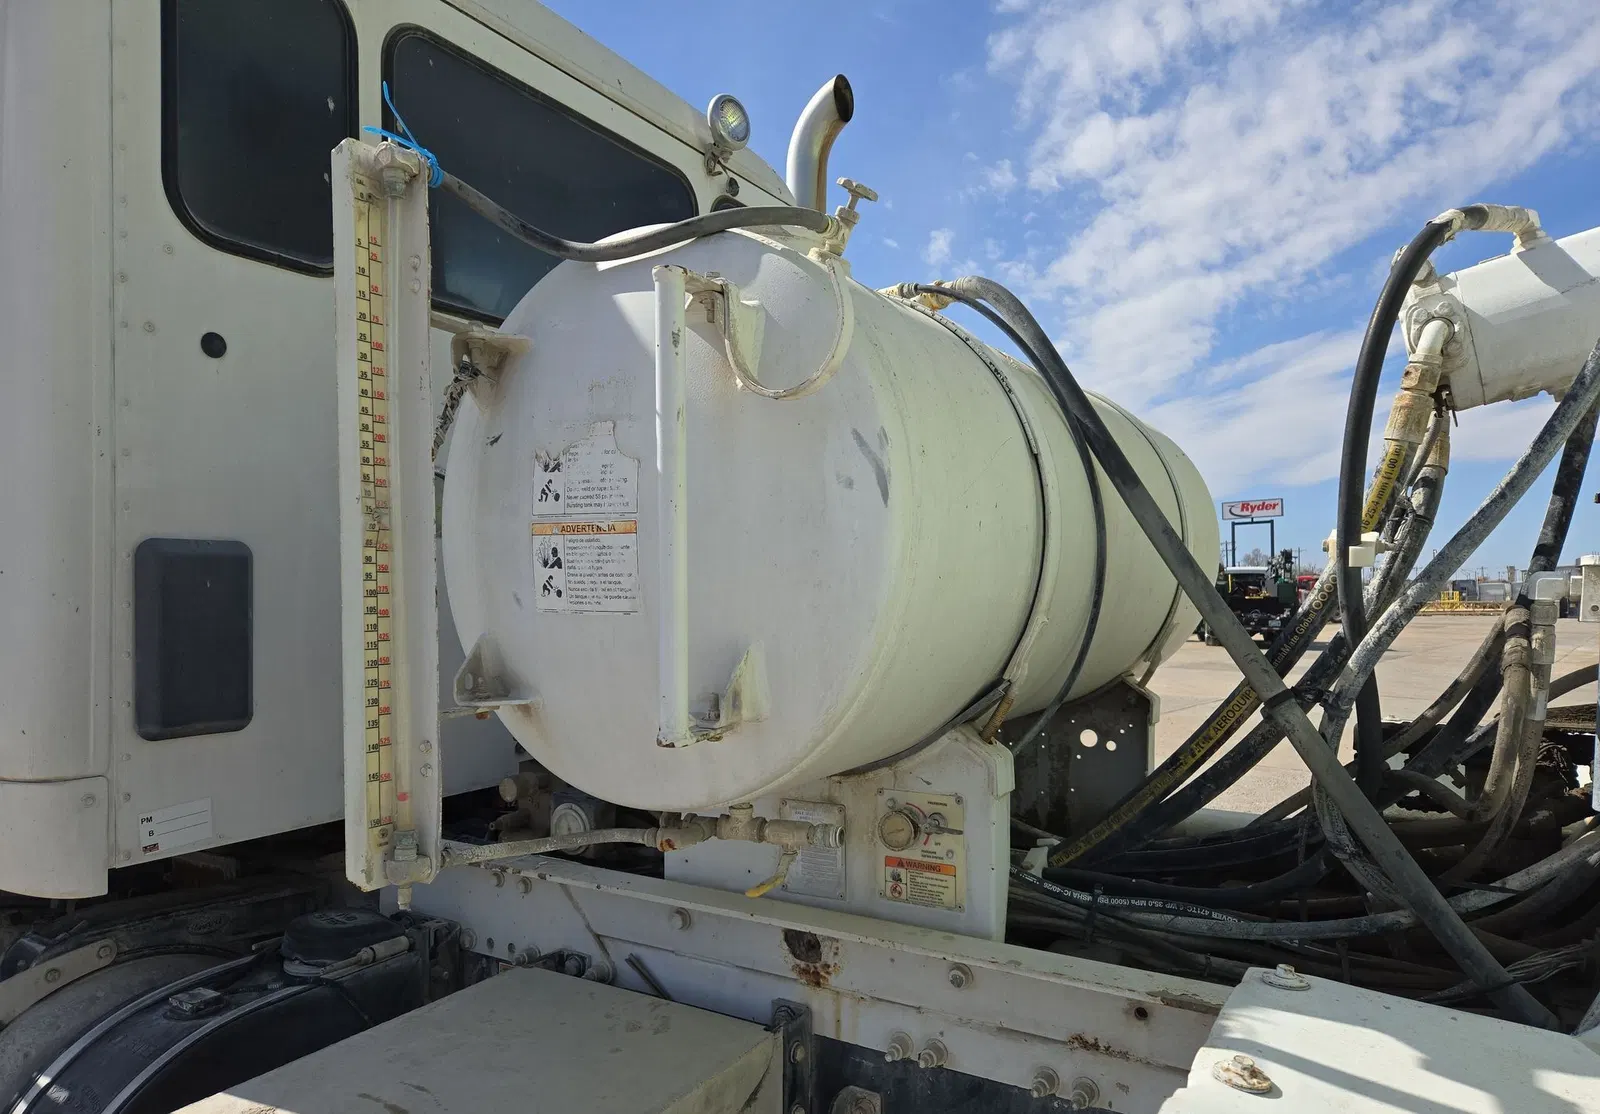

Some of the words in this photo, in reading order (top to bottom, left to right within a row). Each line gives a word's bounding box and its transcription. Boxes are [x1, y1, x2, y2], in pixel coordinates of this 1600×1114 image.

[358, 266, 365, 274] 10
[371, 285, 378, 293] 50
[358, 290, 366, 298] 15
[359, 312, 366, 320] 20
[372, 315, 379, 323] 75
[361, 423, 369, 431] 50
[1381, 457, 1398, 480] (1.00
[1376, 480, 1389, 500] mm
[1240, 501, 1279, 513] Ryder
[1365, 500, 1380, 519] 25.4
[1270, 634, 1300, 668] atchMate
[1295, 609, 1317, 636] Global
[1213, 688, 1254, 735] AEROQUIP
[368, 773, 379, 781] 145
[141, 816, 153, 825] PM
[906, 860, 941, 872] WARNING
[1071, 891, 1093, 902] MSHA
[1110, 897, 1129, 905] (5000
[1130, 898, 1146, 906] MPa
